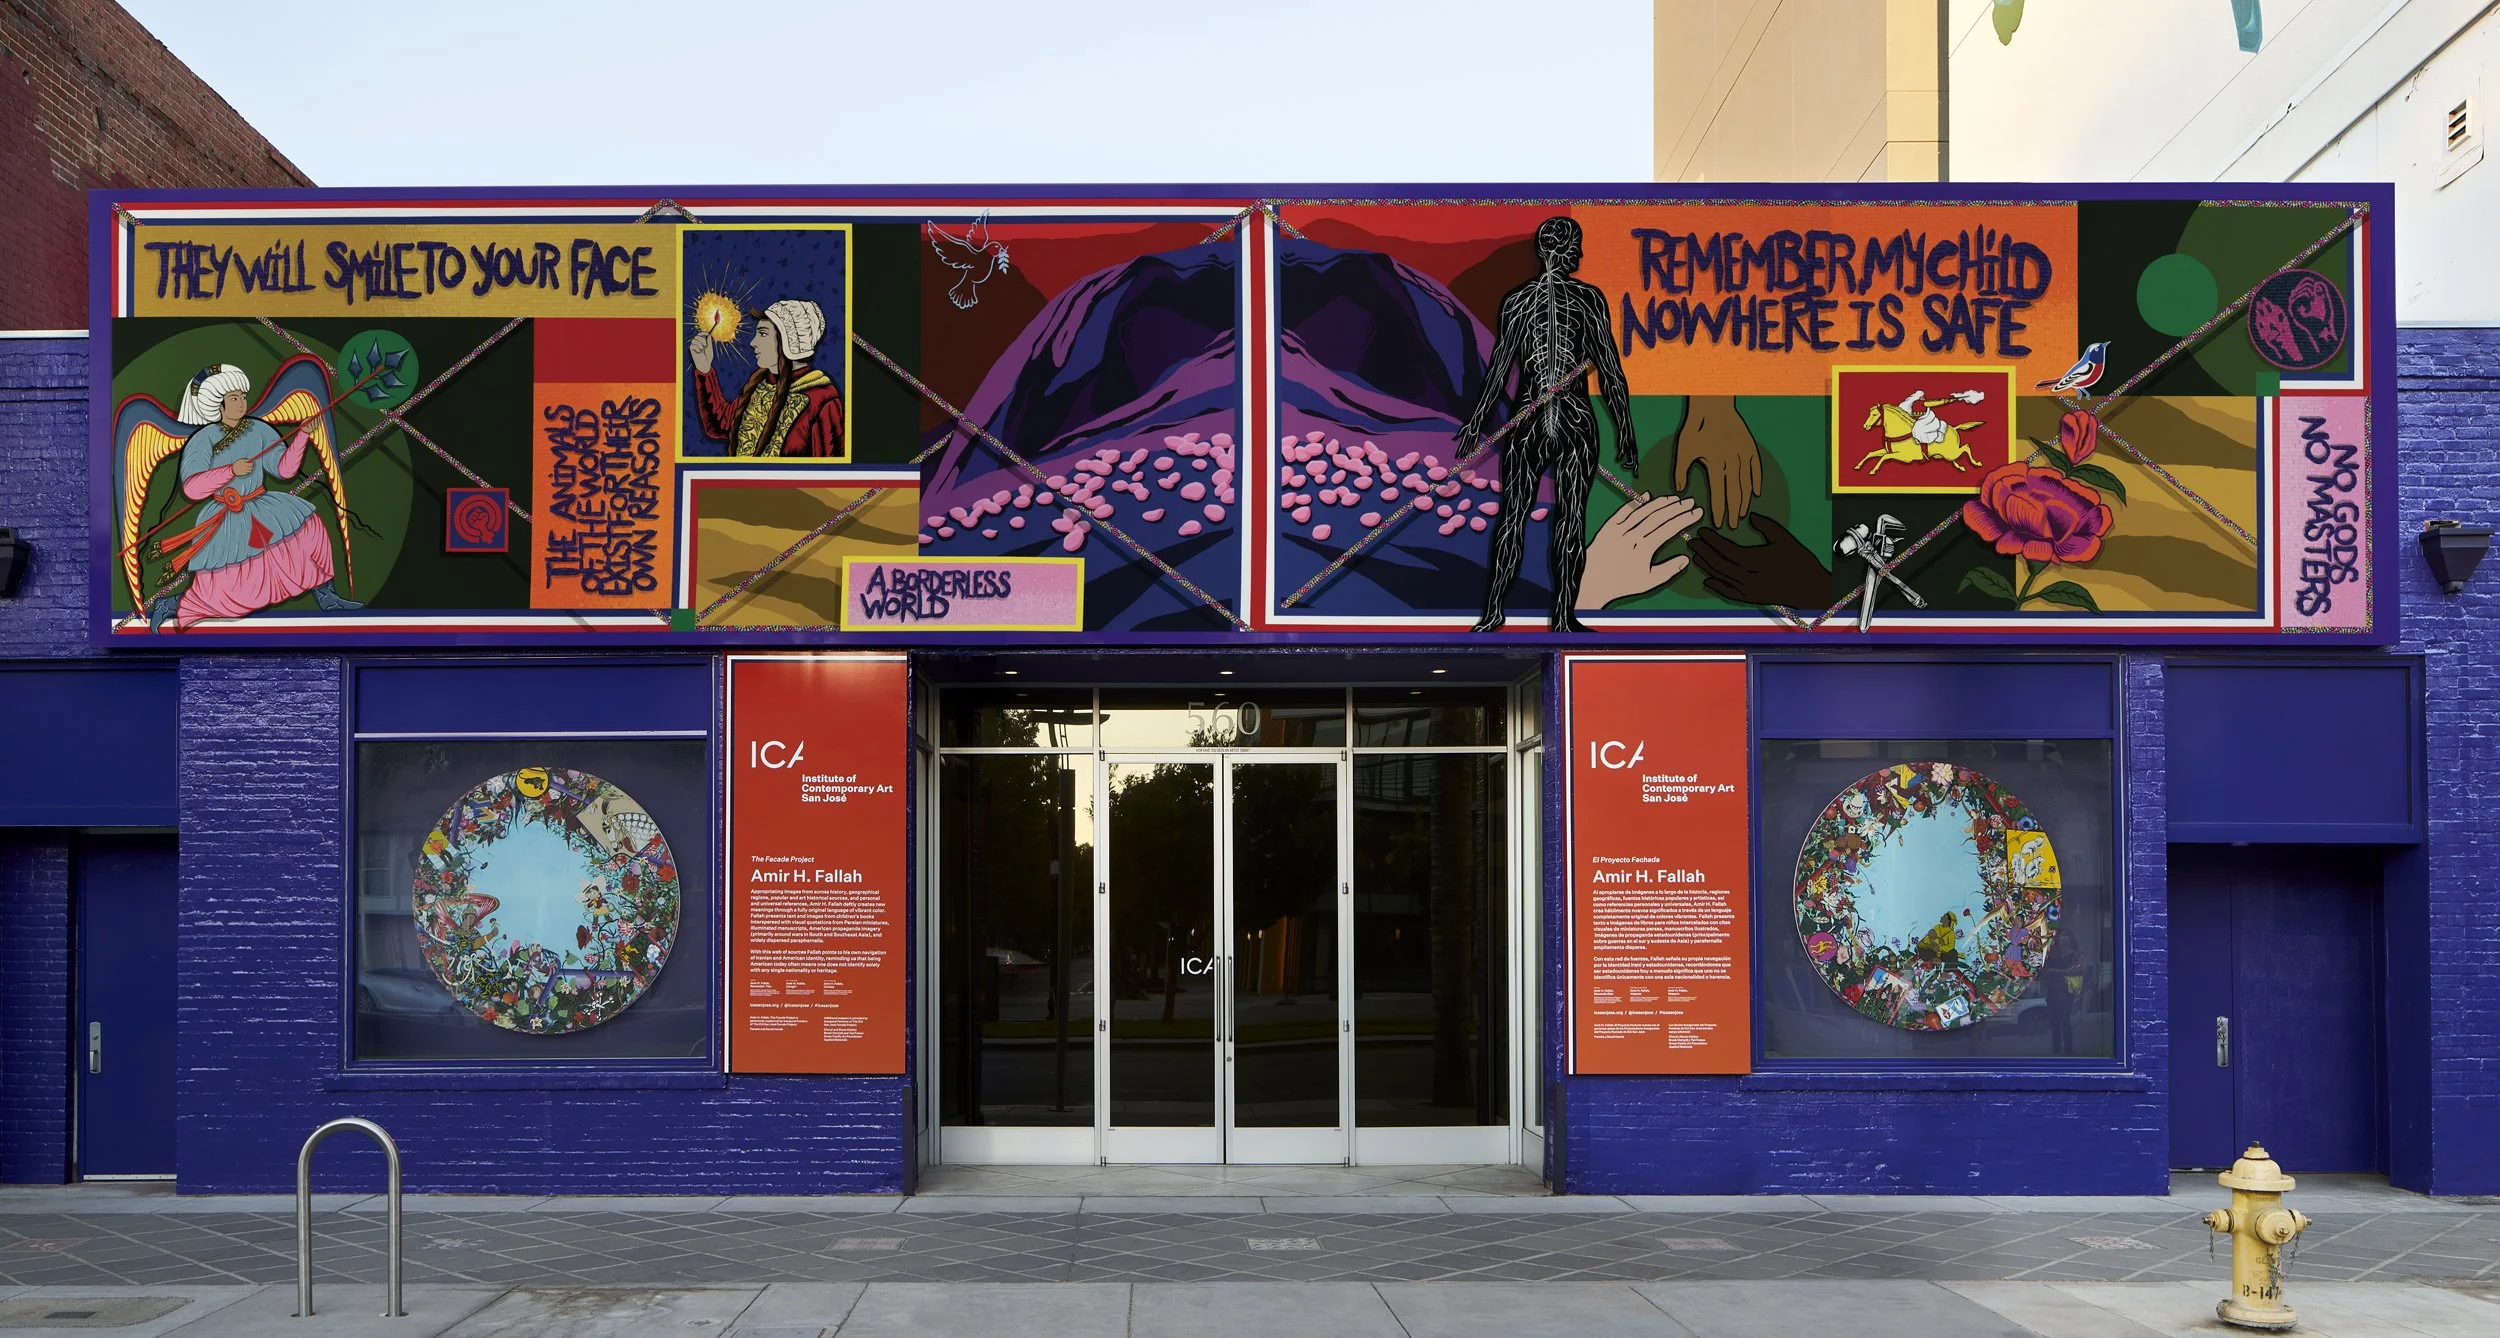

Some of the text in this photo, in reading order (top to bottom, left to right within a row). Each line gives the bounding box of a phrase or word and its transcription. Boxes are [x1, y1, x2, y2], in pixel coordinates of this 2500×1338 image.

[144, 240, 233, 299] THEY
[416, 241, 466, 295] TO
[471, 241, 561, 297] YOUR
[571, 238, 660, 300] FACE
[1860, 229, 1926, 295] MY
[1621, 291, 2034, 357] NOWHERE IS SAFE
[572, 409, 602, 499] WORLD
[544, 404, 581, 589] THE ANIMALS
[599, 395, 635, 596] EXIST FOR THEIR
[627, 397, 661, 592] OWN REASONS
[576, 499, 608, 557] THE
[2295, 416, 2335, 616] NO MASTERS
[2328, 444, 2360, 585] NO GODS
[867, 565, 1011, 599] A BORDERLESS
[860, 593, 950, 623] WORLD
[1185, 702, 1261, 735] 560
[751, 740, 804, 769] ICA
[1591, 740, 1644, 769] ICA
[802, 774, 857, 783] Institute of
[802, 784, 893, 794] Contemporary Art
[1642, 774, 1698, 783] Institute of
[1642, 784, 1735, 794] Contemporary Art
[801, 794, 847, 802] San José
[1642, 794, 1688, 802] San José
[751, 869, 862, 883] Amir H. Fallah
[1593, 869, 1705, 883] Amir H. Fallah
